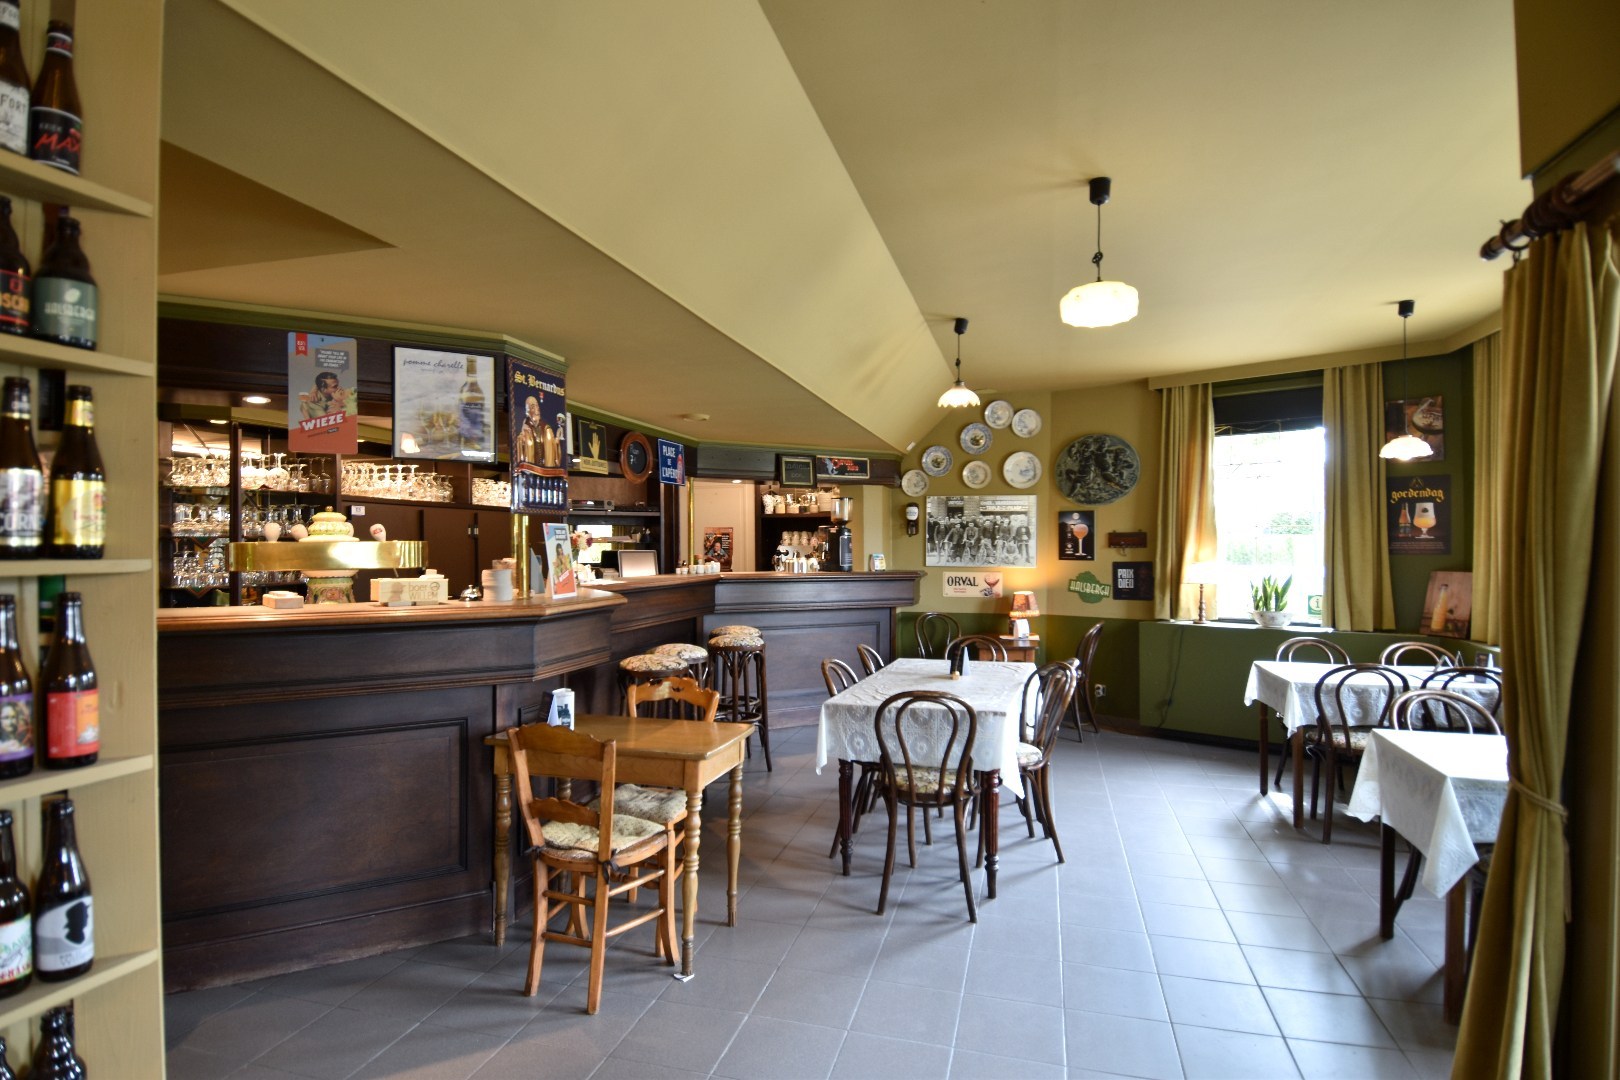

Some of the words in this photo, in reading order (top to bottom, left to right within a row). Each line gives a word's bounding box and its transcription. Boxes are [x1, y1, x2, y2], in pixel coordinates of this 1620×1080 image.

[528, 374, 565, 397] Bernardus
[302, 413, 344, 431] WIEZE
[1390, 488, 1445, 503] goedendag
[1117, 568, 1134, 579] PAIX
[408, 581, 428, 591] boer
[947, 575, 978, 587] ORVAL
[1117, 579, 1134, 589] DIEU
[1069, 580, 1111, 597] HALSBERGH
[408, 591, 438, 600] WILLEM
